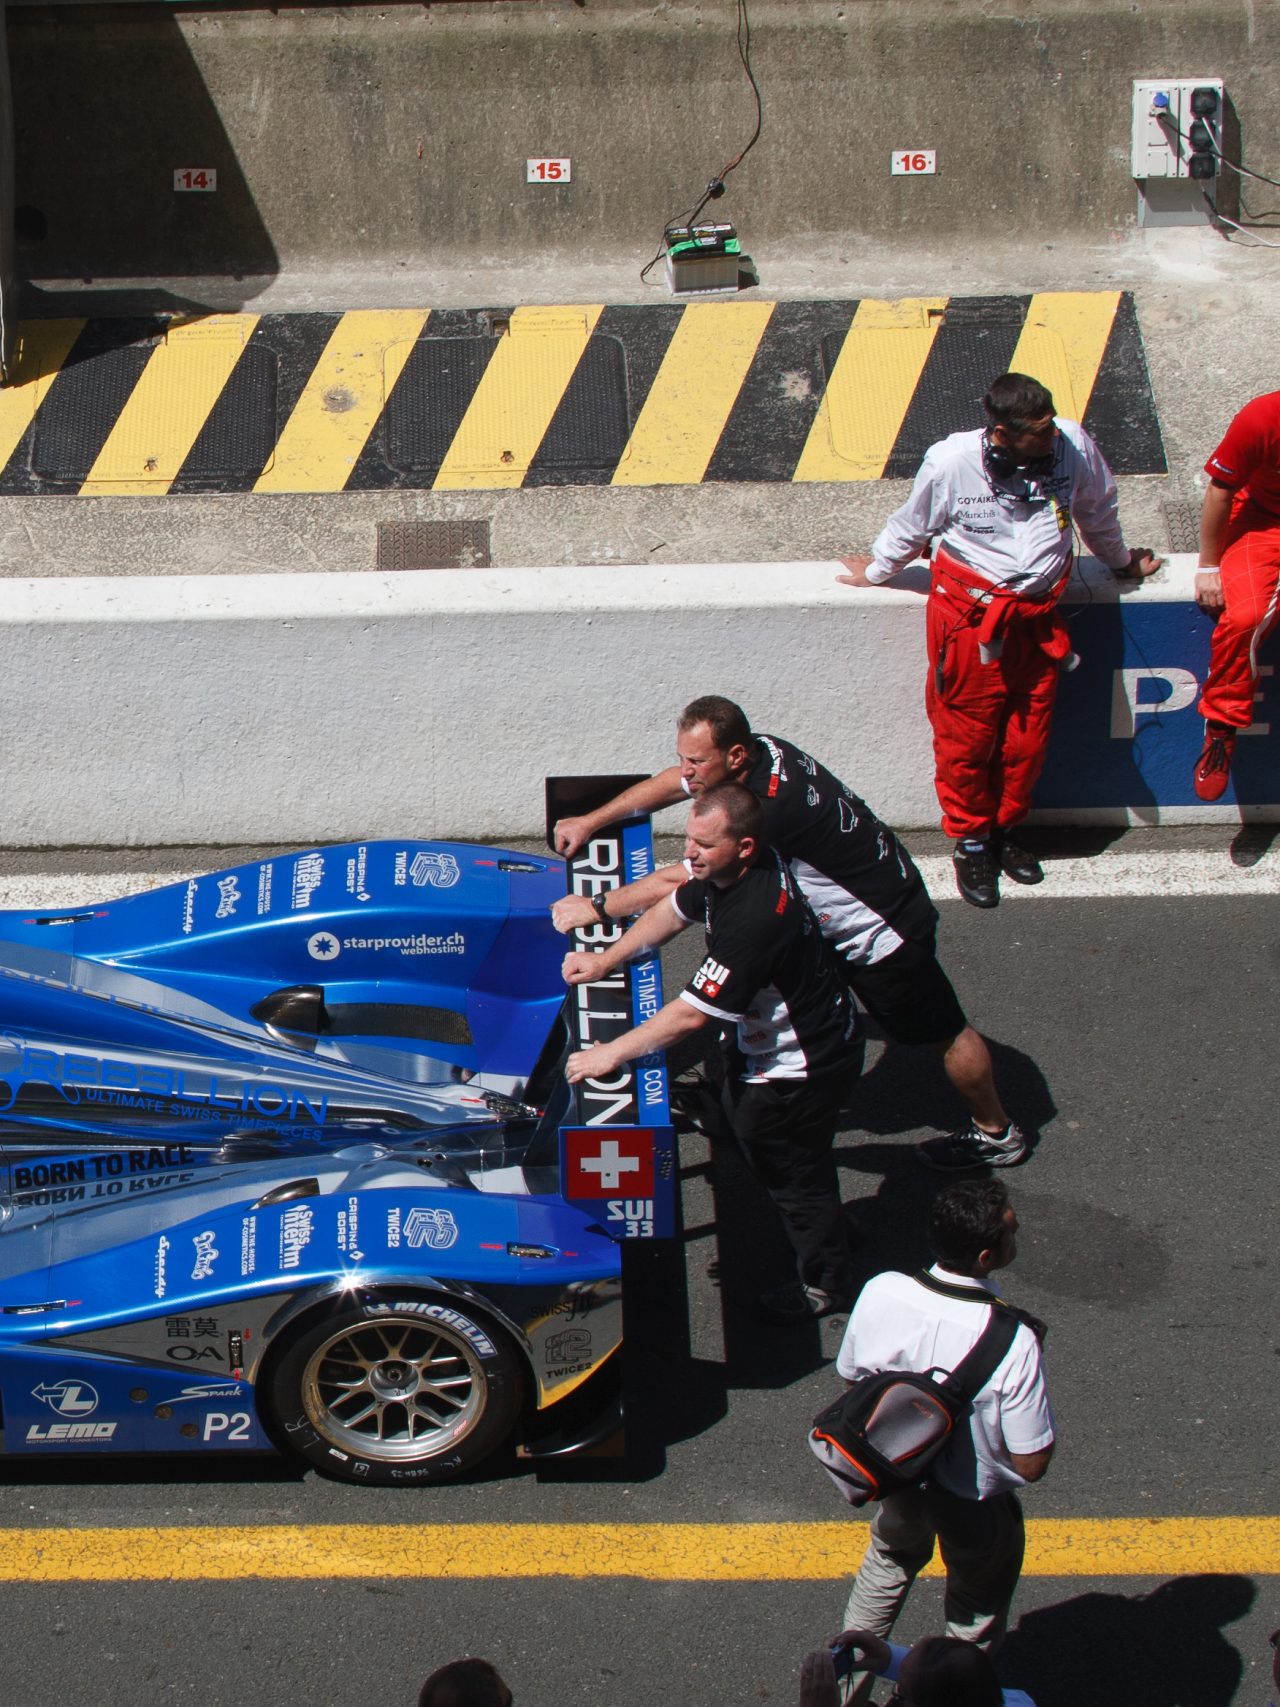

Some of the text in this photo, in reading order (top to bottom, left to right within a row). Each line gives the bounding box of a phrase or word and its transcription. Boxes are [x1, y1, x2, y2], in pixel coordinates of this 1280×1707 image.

[536, 163, 562, 179] 15
[901, 155, 926, 171] 16
[182, 171, 208, 189] 14
[343, 932, 464, 950] starprovider.ch
[572, 838, 635, 1126] REBLLON
[23, 1048, 328, 1125] REBELLION
[86, 1088, 164, 1114] ULTIMATE
[169, 1104, 222, 1122] SWISS
[15, 1142, 195, 1189] BORN TO RACE
[607, 1200, 654, 1221] SUI
[387, 1208, 400, 1248] TWICE2
[625, 1221, 654, 1238] 33
[393, 1301, 496, 1357] MICHELIN
[546, 1362, 593, 1379] TWICE2
[26, 1422, 118, 1439] LEMO
[203, 1413, 251, 1441] P2
